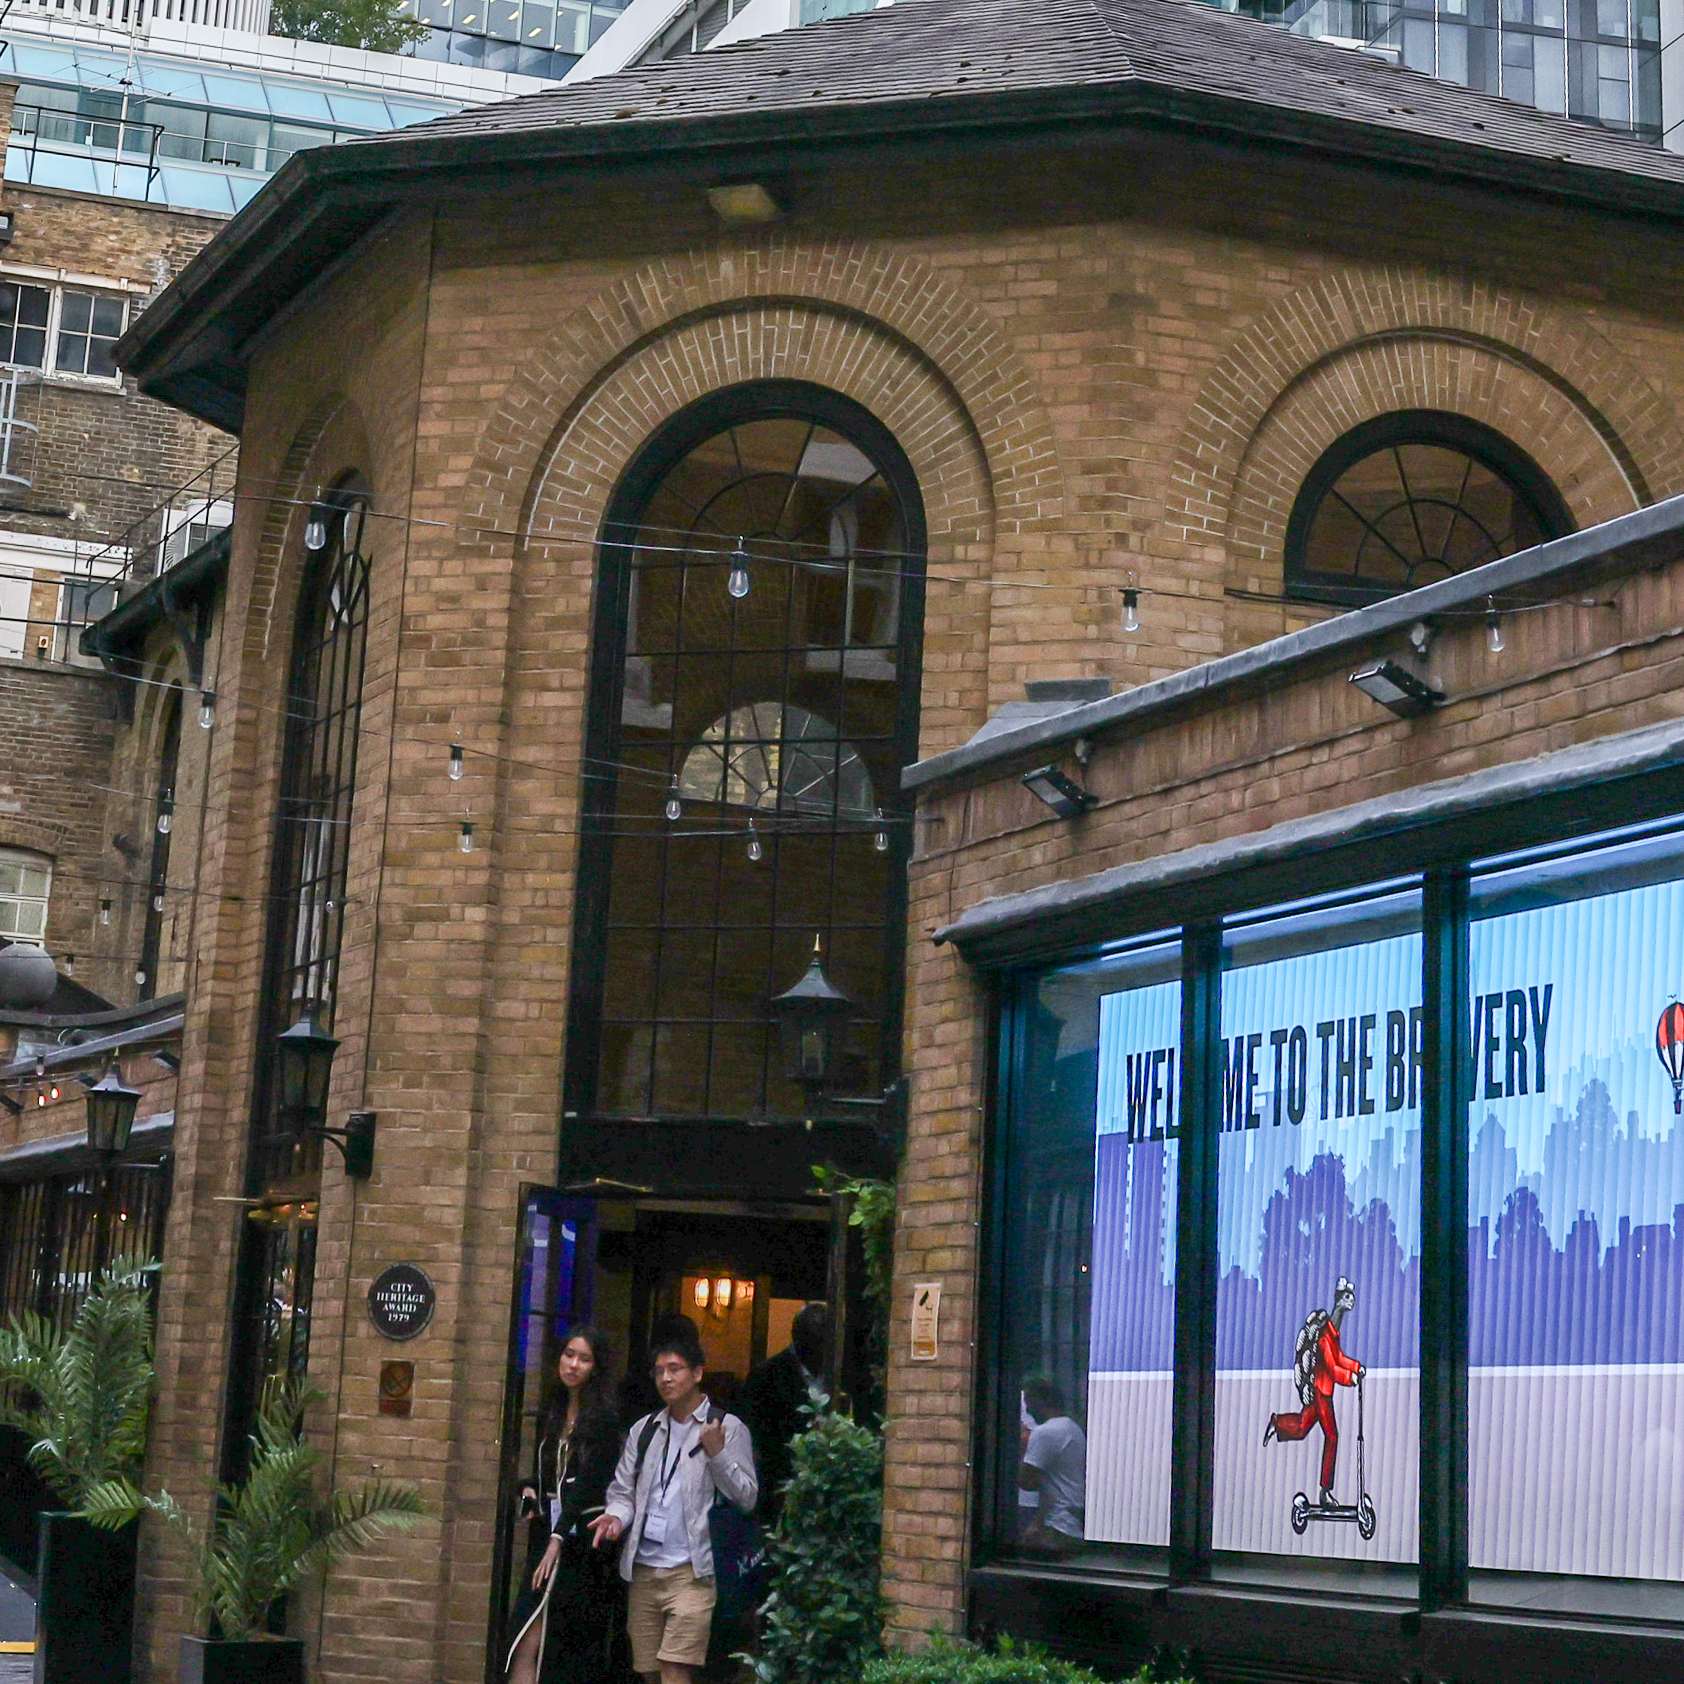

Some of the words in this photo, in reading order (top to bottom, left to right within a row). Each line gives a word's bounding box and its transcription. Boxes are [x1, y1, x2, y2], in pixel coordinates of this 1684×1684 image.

[1126, 1033, 1261, 1144] WELME
[1270, 1025, 1307, 1127] TO
[1316, 1014, 1376, 1121] THE
[390, 1283, 414, 1293] CITY
[377, 1292, 426, 1304] HERITAGE
[383, 1303, 417, 1313] AWARD
[388, 1313, 410, 1322] 1979
